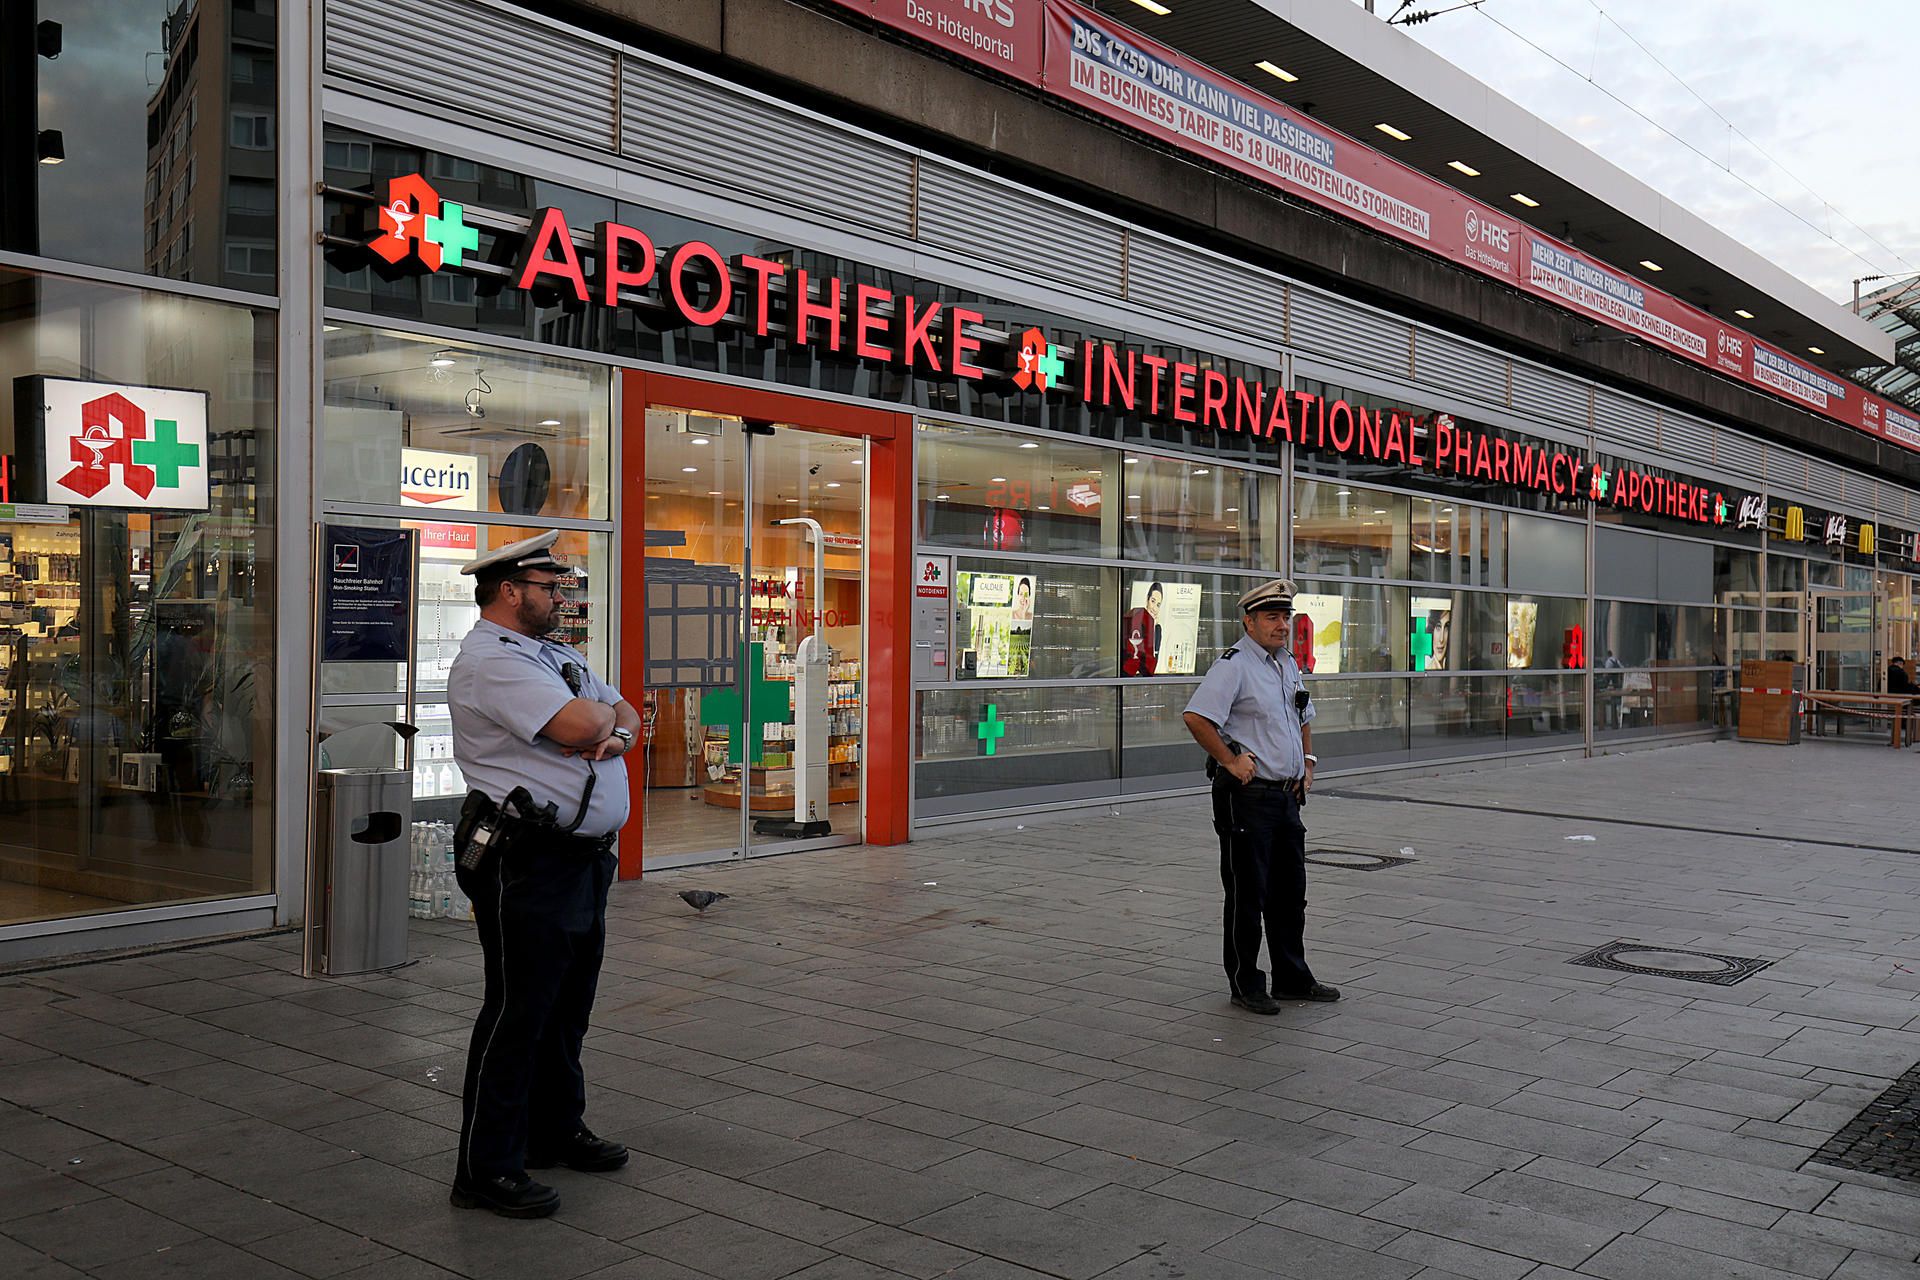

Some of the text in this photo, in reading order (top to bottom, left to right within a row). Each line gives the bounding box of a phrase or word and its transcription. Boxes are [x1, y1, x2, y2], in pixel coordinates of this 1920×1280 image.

[949, 0, 1015, 28] RS
[906, 0, 1014, 62] Das Hotelportal
[1073, 24, 1334, 165] BIS 17:59 UHR KANN VIEL PASSIEREN:
[1074, 59, 1428, 235] IM BUSINESS TARIF BIS 18 UHR KOSTENLOS STORNIEREN.
[1480, 219, 1510, 253] HRS
[1465, 244, 1510, 274] Das Hotelportal
[1532, 241, 1554, 266] MEHR
[1572, 260, 1604, 289] WENIGER
[1604, 275, 1644, 307] FORMULARE:
[517, 206, 984, 380] APOTHEKE
[1532, 264, 1557, 288] DATEN
[1557, 277, 1583, 301] ONLINE
[1584, 289, 1627, 320] HINTERLEGEN
[1627, 308, 1640, 326] UND
[1641, 313, 1673, 340] SCHNELLER
[1726, 335, 1742, 358] HRS
[1083, 340, 1580, 496] INTERNATIONAL PHARMACY
[401, 463, 469, 490] ucerin
[1614, 467, 1709, 523] APOTHEKE
[423, 528, 470, 542] Ihrer Haut
[333, 577, 362, 585] Rauchfreier
[751, 579, 805, 600] HEKE
[918, 587, 946, 595] NOTDIENST
[751, 607, 850, 628] BAHNHOF
